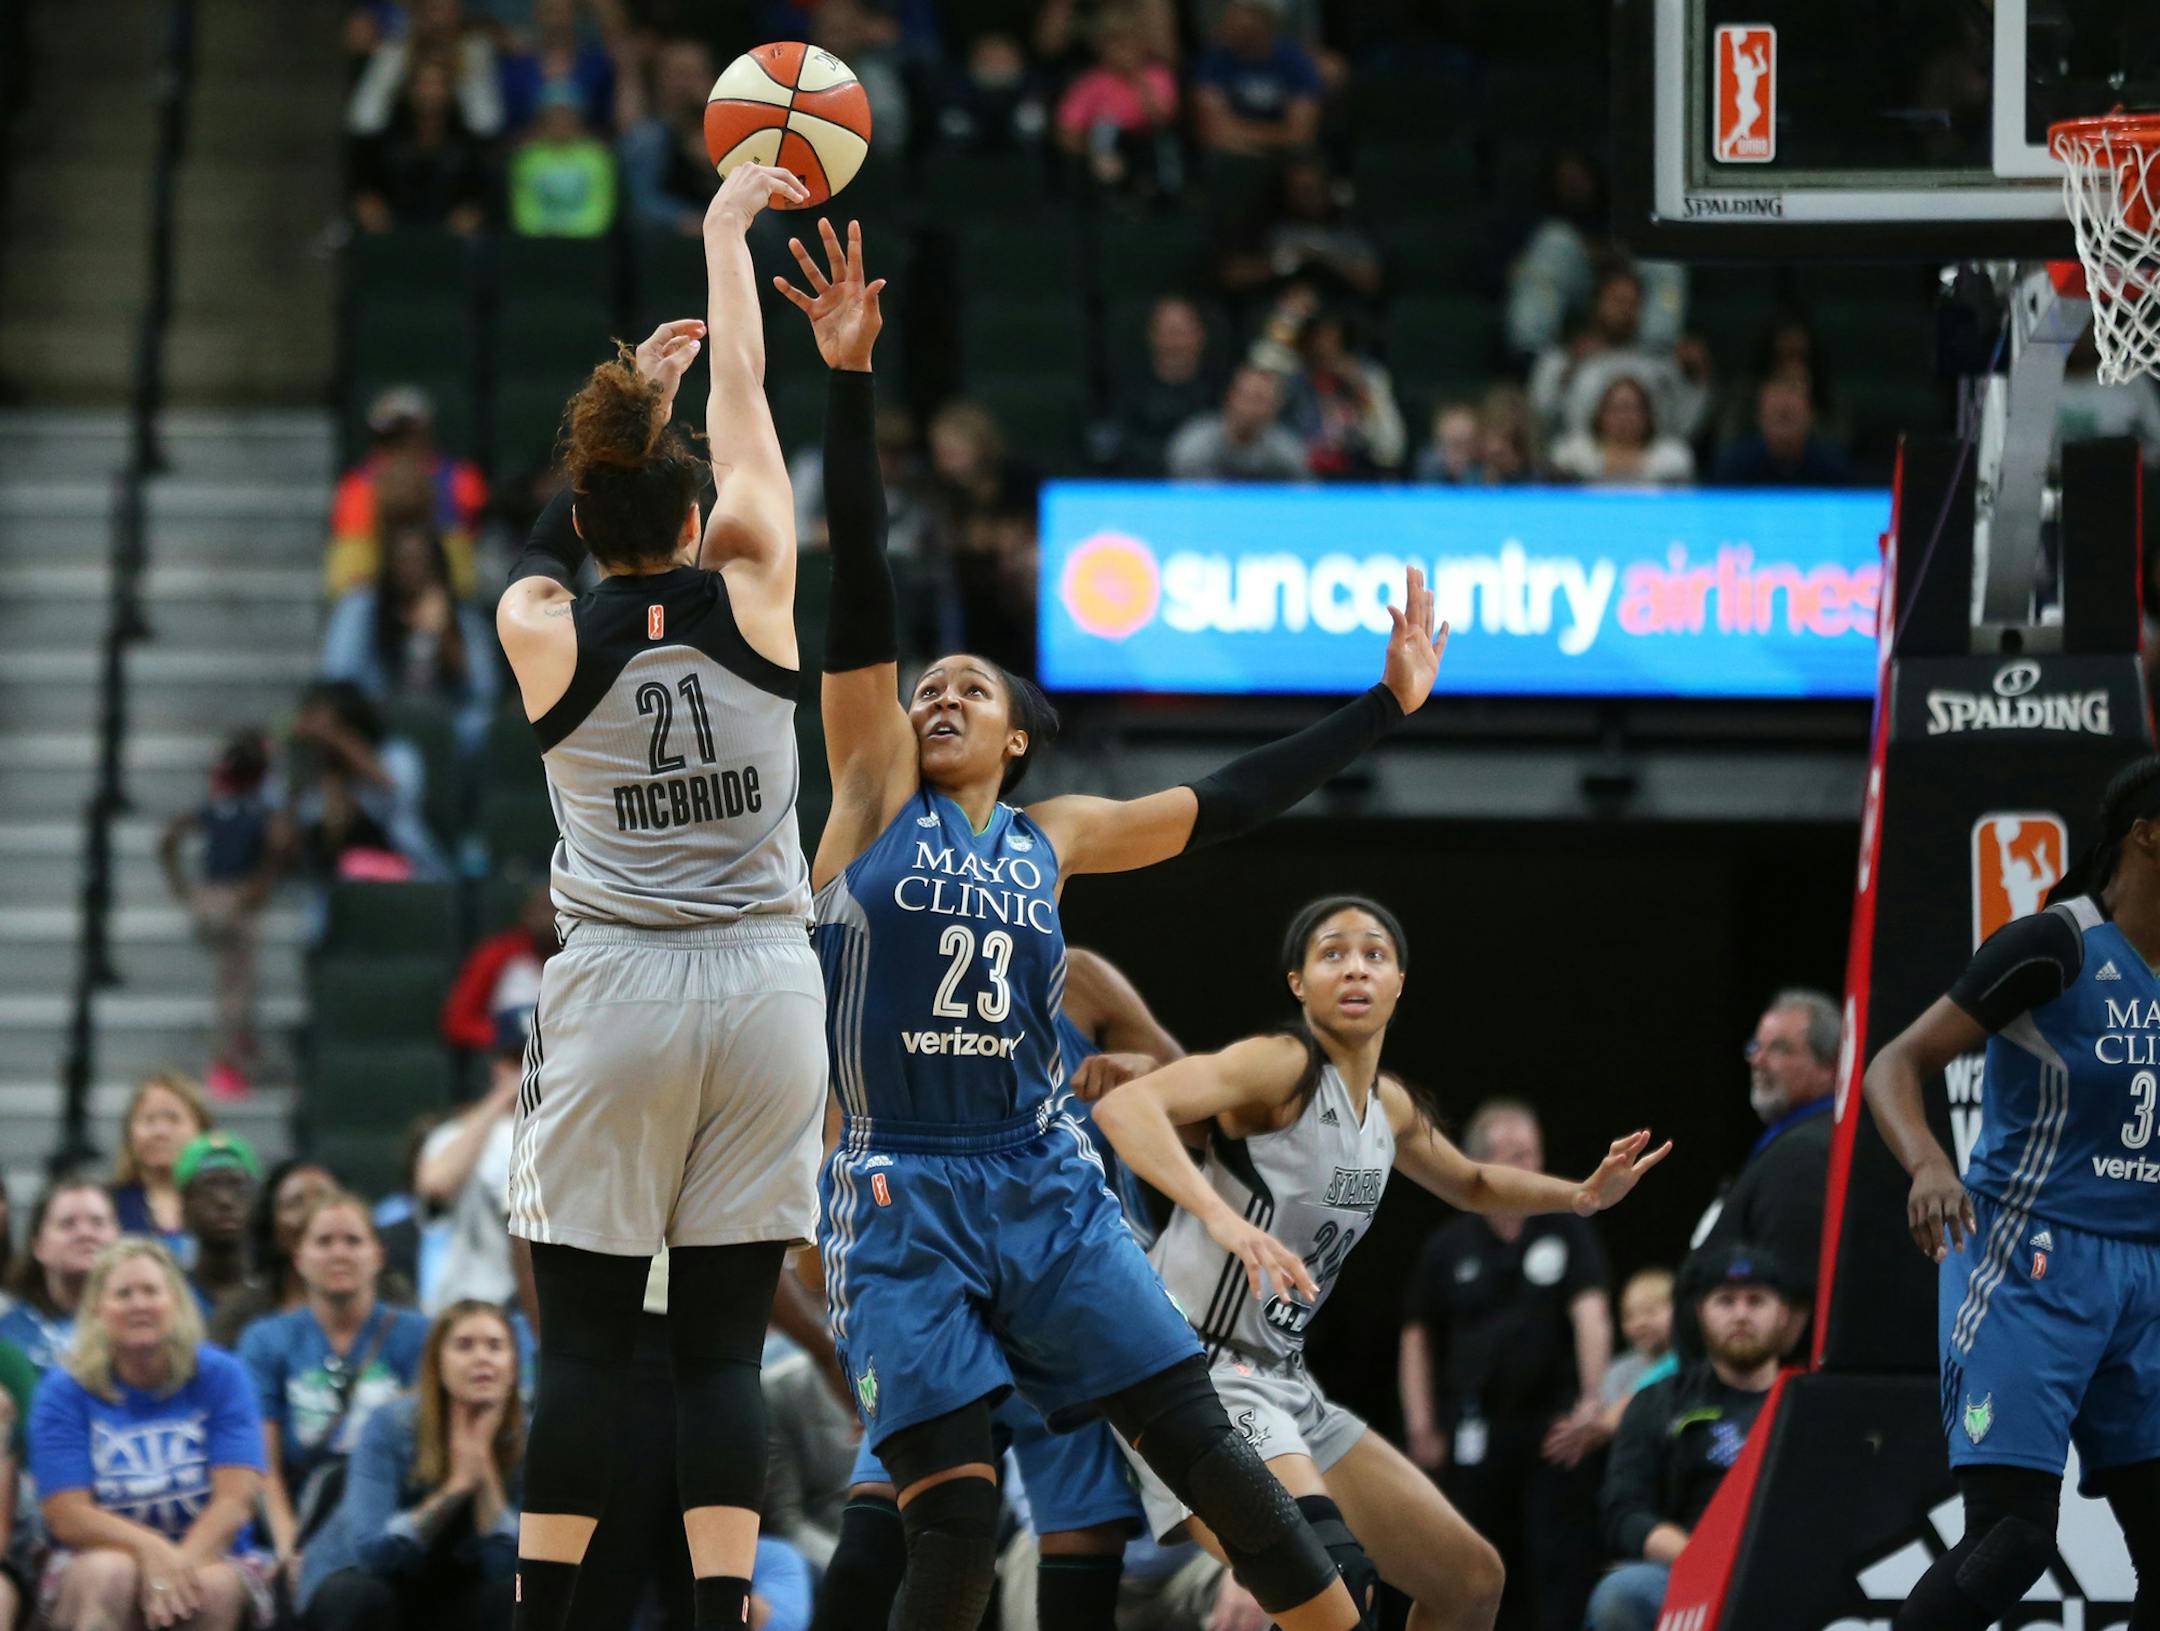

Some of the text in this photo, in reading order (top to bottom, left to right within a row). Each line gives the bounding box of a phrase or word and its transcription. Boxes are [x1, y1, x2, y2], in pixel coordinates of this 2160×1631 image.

[1683, 196, 1784, 219] SPALDING
[635, 672, 717, 776] 21
[1926, 688, 2111, 736] SPALDING
[911, 840, 1042, 890] MAYO
[893, 875, 1054, 935] CLINIC
[932, 924, 1014, 1024] 23
[2094, 1035, 2160, 1065] CLI
[2120, 1071, 2160, 1150] 3
[1321, 1166, 1383, 1206] STARS
[2092, 1156, 2160, 1187] veriz
